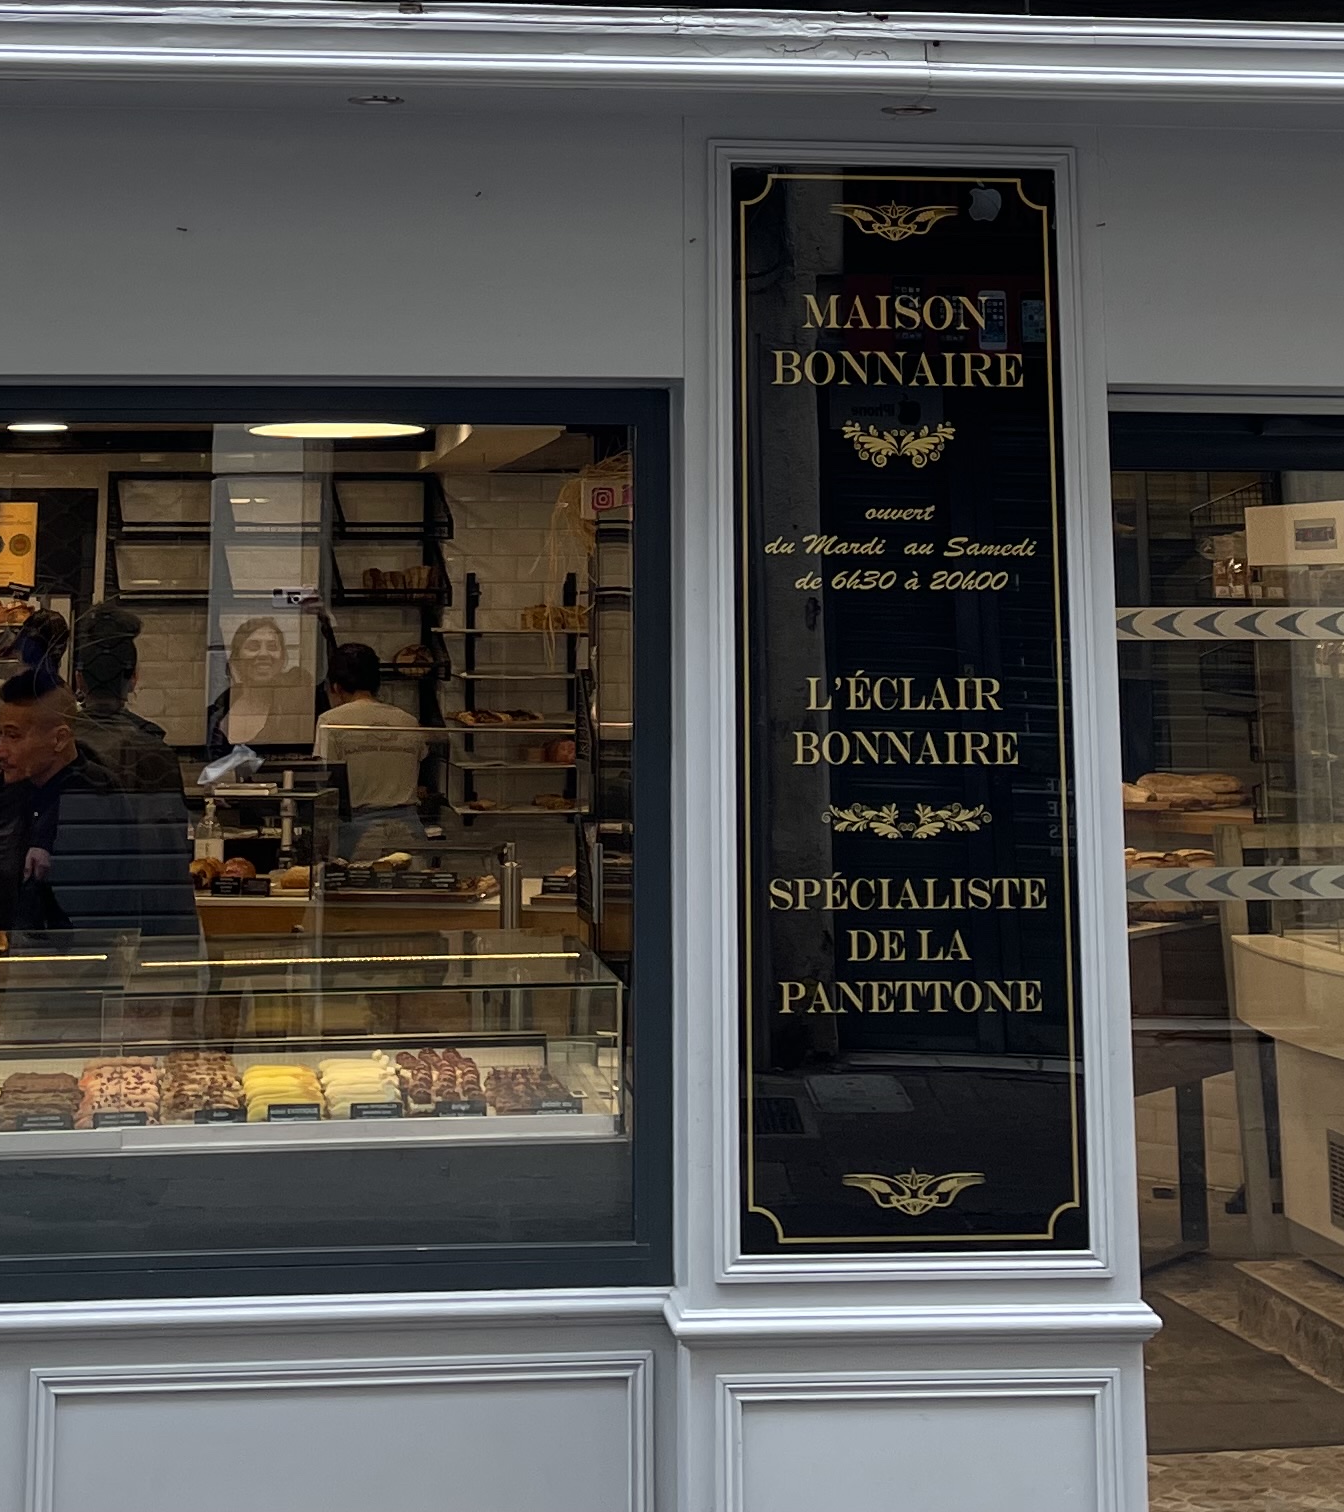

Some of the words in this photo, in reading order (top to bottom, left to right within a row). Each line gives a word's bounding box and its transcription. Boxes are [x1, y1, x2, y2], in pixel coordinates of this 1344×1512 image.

[803, 294, 989, 330] MAISON
[772, 351, 1024, 388] BONNAIRE
[865, 505, 936, 521] ouvert
[764, 536, 795, 555] du
[802, 534, 886, 556] Mardi
[904, 542, 934, 555] au
[943, 537, 1037, 557] Samedi
[795, 571, 823, 590] de
[831, 570, 897, 590] 6h30
[904, 570, 921, 590] à
[929, 571, 1009, 590] 20h00
[806, 670, 1002, 710] L'ÉCLAIR
[793, 731, 1019, 765] BONNAIRE
[768, 872, 1048, 910] SPÉCIALISTE
[848, 930, 907, 961] DE
[918, 930, 972, 961] LA
[779, 980, 1043, 1013] PANETTONE
